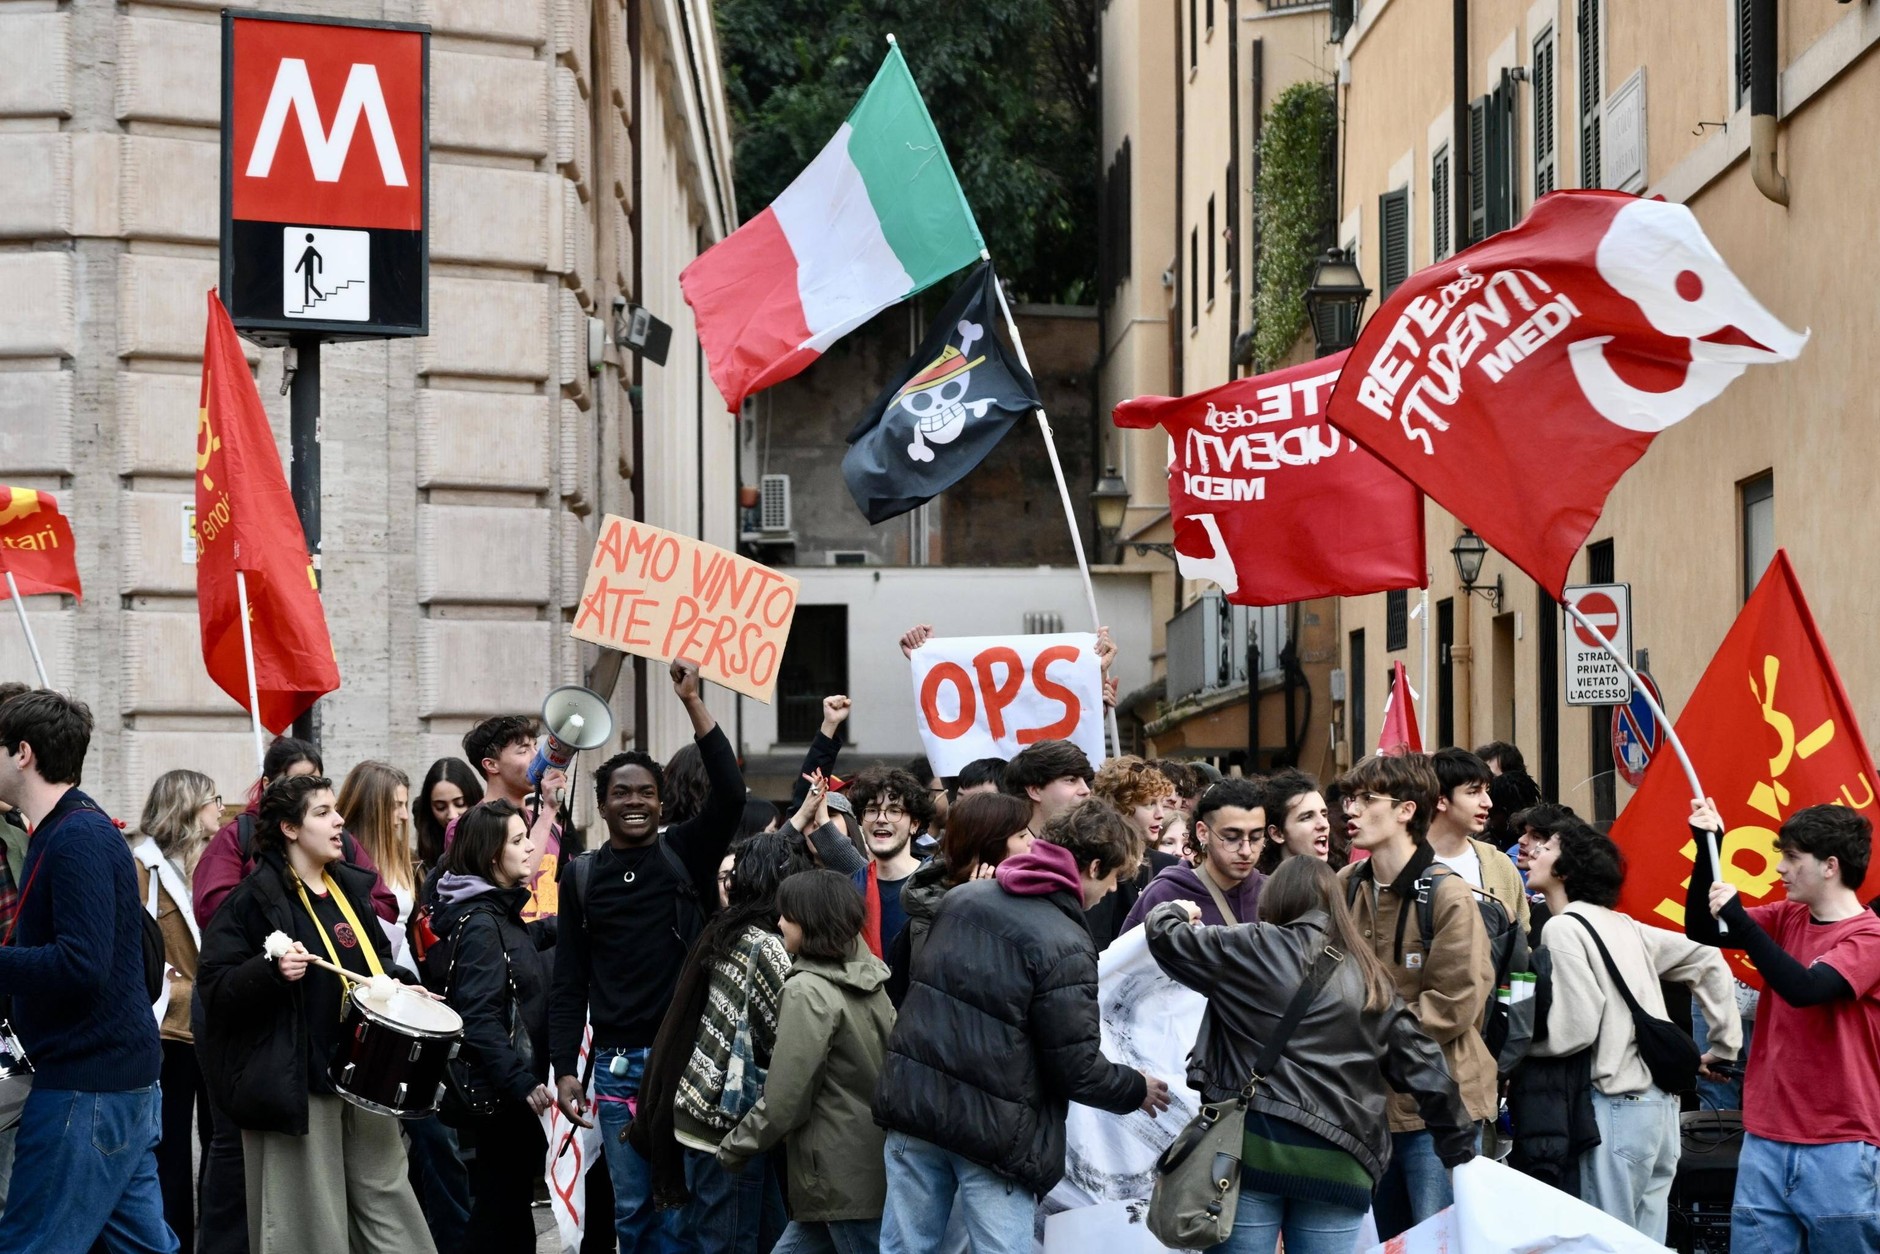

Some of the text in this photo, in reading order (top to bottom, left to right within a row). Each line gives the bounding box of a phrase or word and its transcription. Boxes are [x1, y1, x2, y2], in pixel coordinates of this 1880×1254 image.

[245, 58, 409, 187] M
[1356, 295, 1450, 420] RETE
[1400, 269, 1553, 455] STUDENTI
[1477, 293, 1583, 384] MEDI
[595, 520, 794, 629] AMO VINTO
[576, 576, 777, 687] ATE PERSO
[1577, 651, 1615, 662] STRAD
[1577, 664, 1618, 674] PRIVATA
[920, 645, 1081, 745] OPS
[1570, 689, 1626, 700] L'ACCESSO
[1577, 677, 1619, 687] VIETATO
